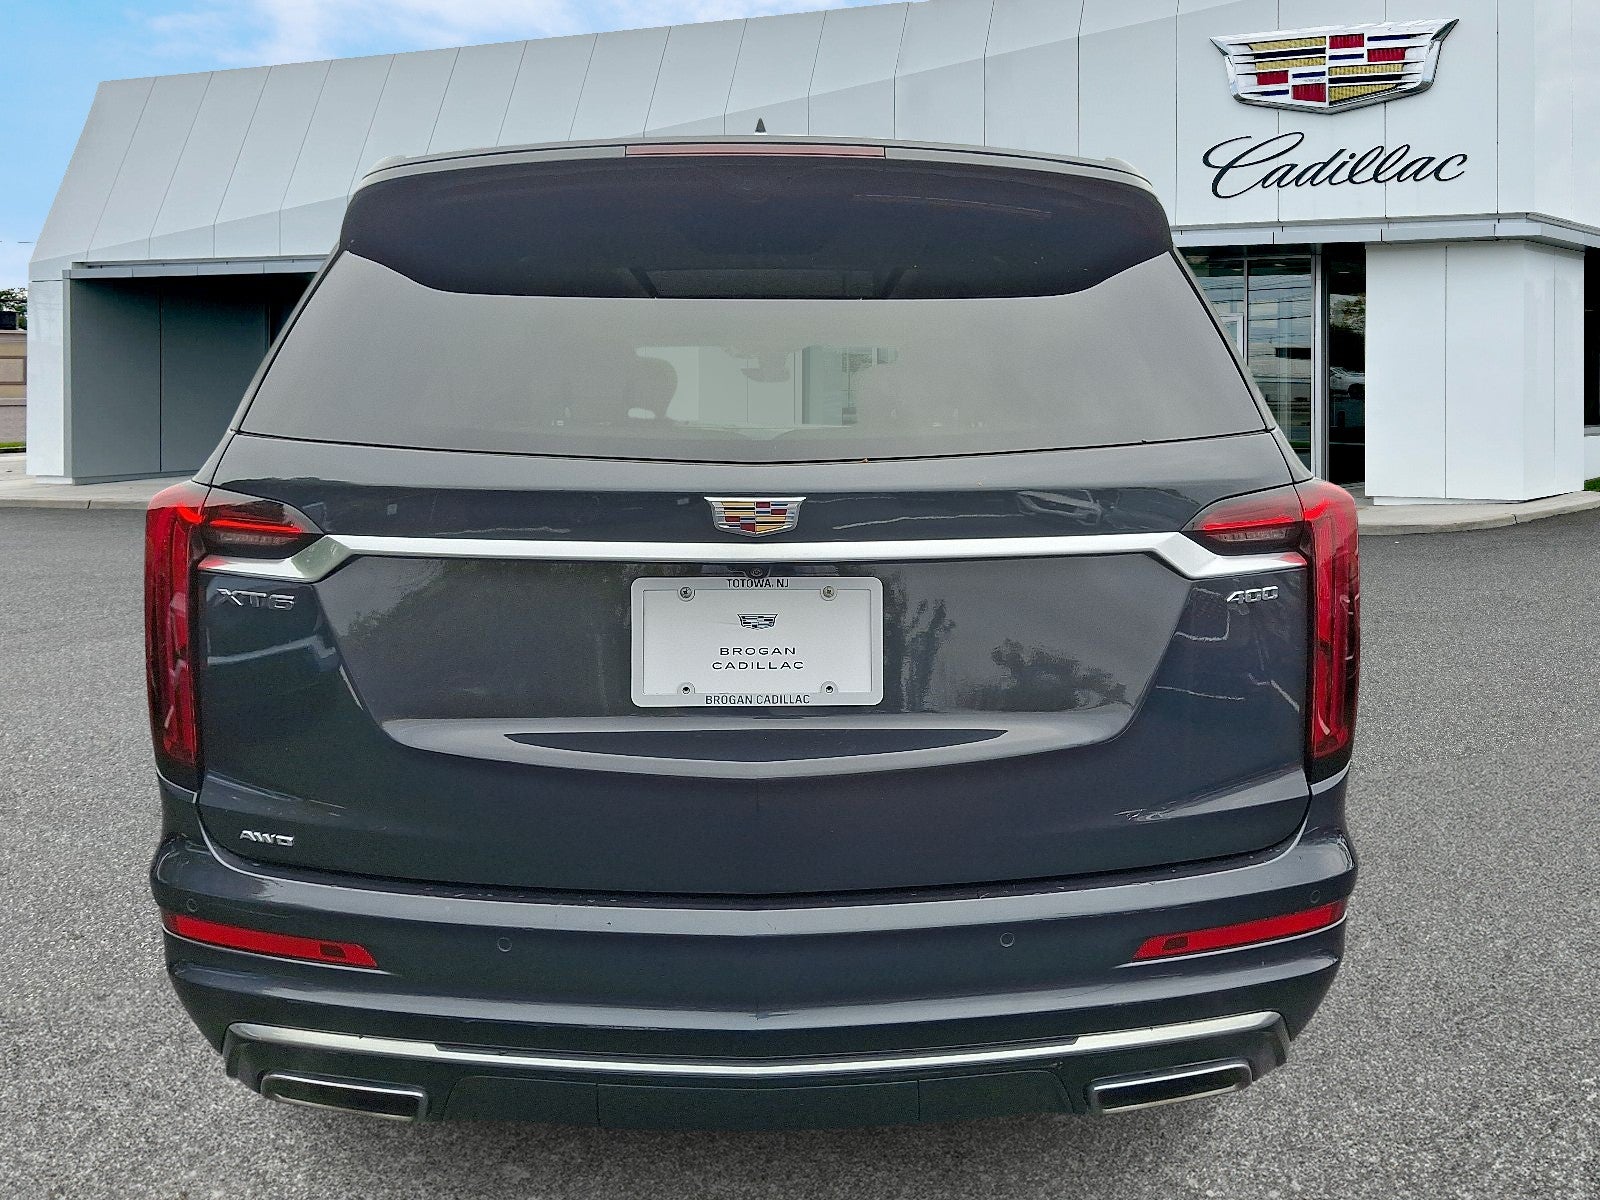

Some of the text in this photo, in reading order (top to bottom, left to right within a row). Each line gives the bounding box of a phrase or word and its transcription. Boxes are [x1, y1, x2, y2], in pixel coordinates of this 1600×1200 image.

[1202, 131, 1468, 198] Cadillac
[776, 578, 789, 588] NJ
[216, 588, 295, 611] XT6
[1226, 585, 1279, 604] 400
[719, 647, 796, 656] BROGAN
[712, 661, 804, 670] CADILLAC
[705, 694, 810, 705] BROGAN CADILLAC
[240, 829, 294, 846] AWD
